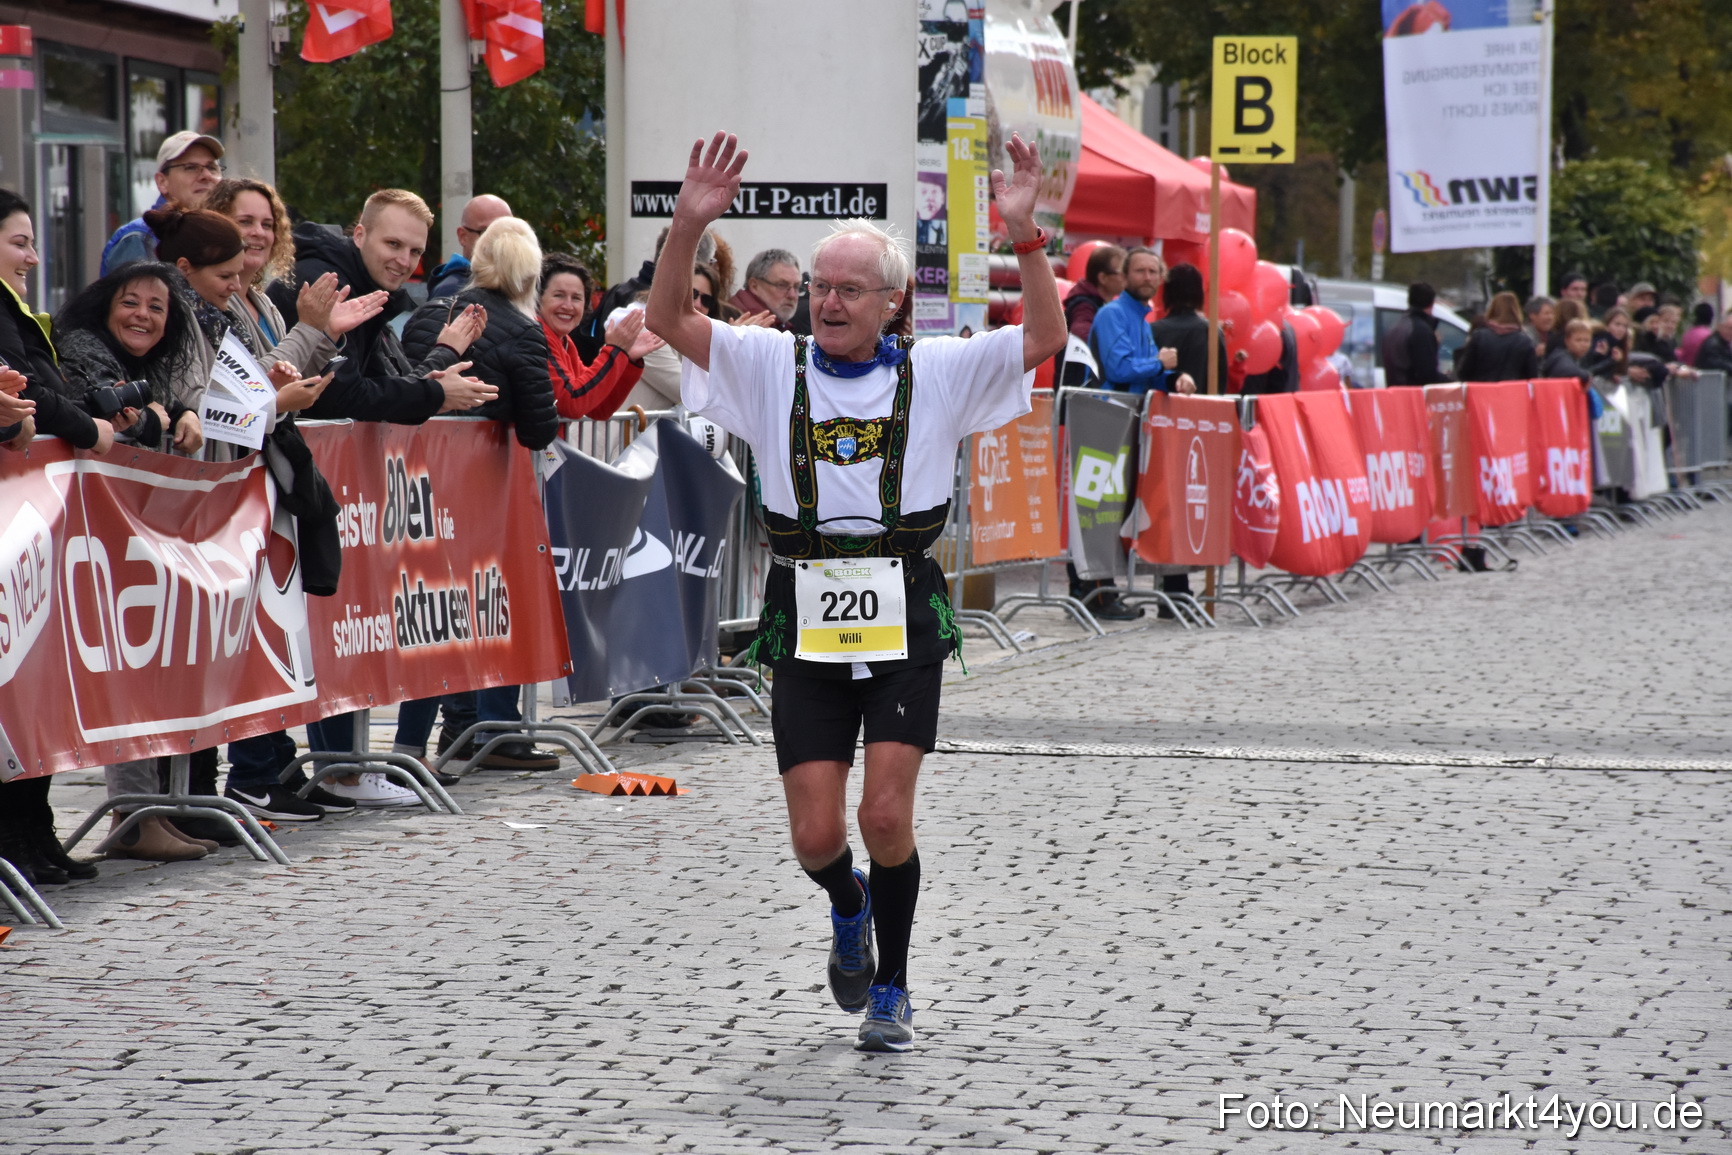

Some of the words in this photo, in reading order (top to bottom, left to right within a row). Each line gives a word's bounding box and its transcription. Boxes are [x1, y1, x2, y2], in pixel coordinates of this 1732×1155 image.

[1223, 42, 1287, 65] Block
[1234, 76, 1274, 135] B
[216, 350, 250, 381] swn
[205, 407, 238, 425] wn
[382, 455, 435, 546] 80er
[10, 531, 47, 638] NEUE
[834, 568, 872, 577] BOCK
[473, 565, 511, 640] Hits
[820, 589, 879, 622] 220
[838, 632, 862, 645] Willi
